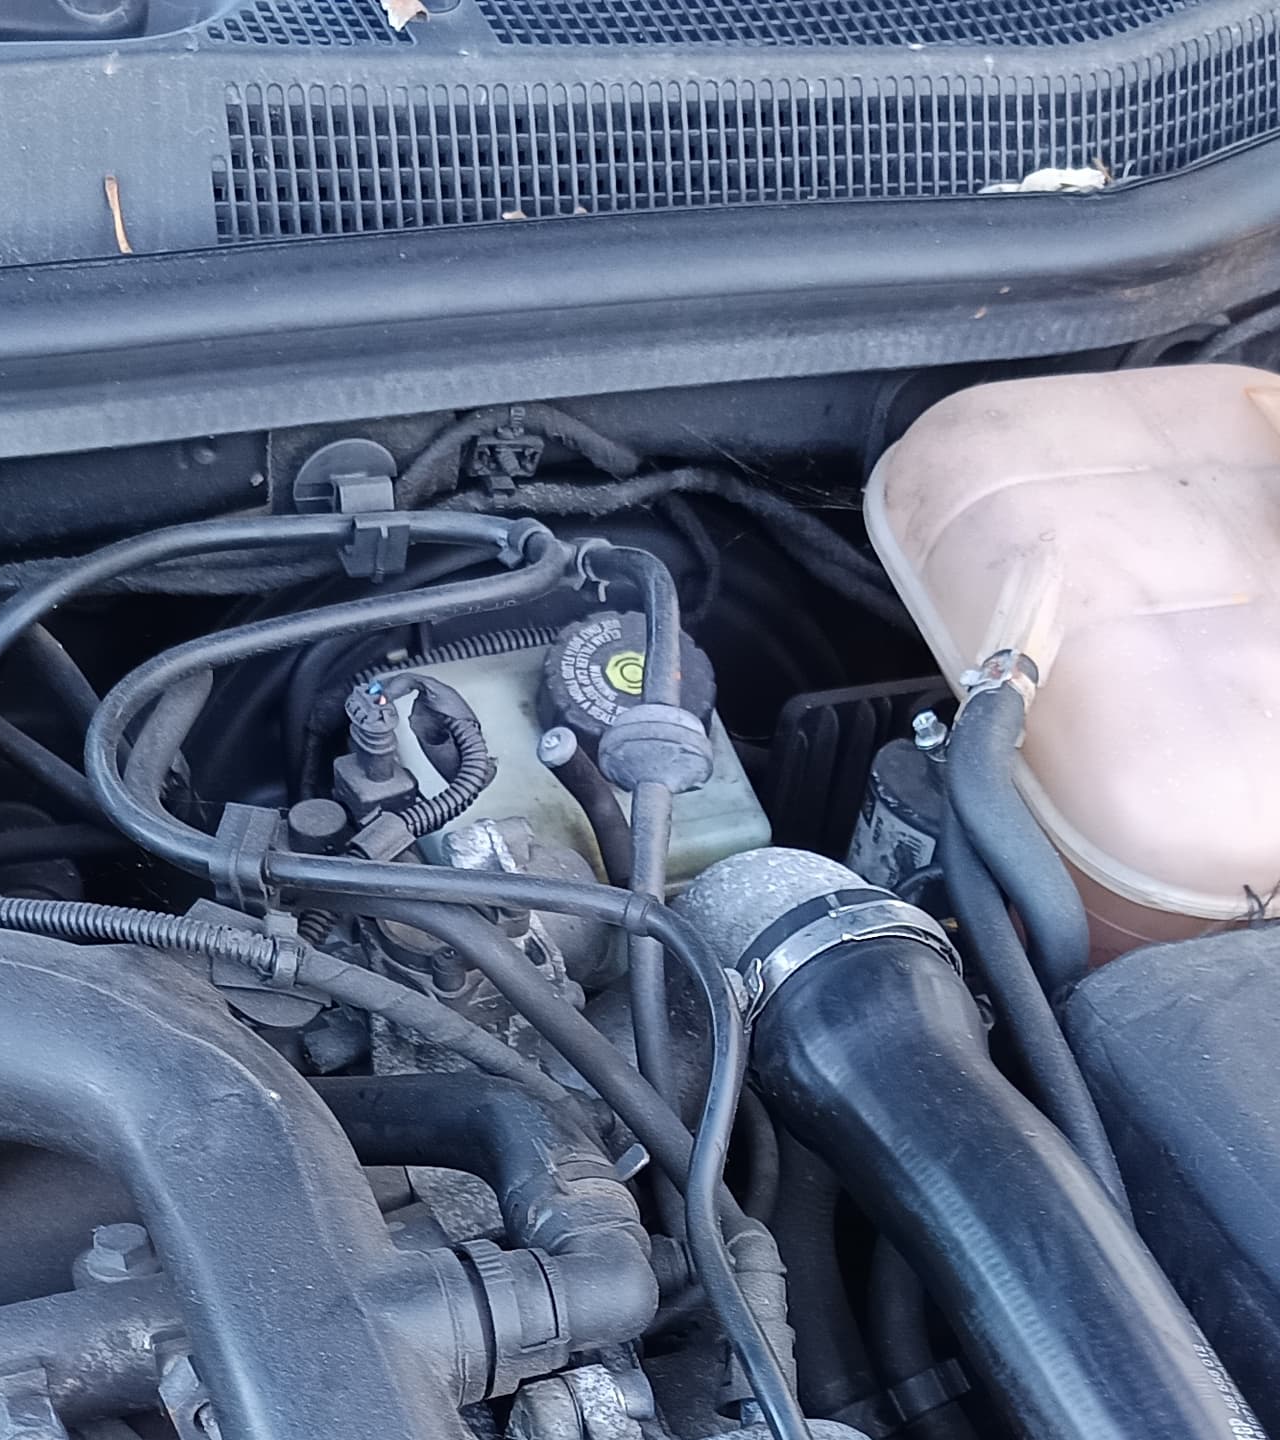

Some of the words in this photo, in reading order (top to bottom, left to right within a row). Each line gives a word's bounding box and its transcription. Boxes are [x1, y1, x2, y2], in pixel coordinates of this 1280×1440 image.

[580, 623, 603, 640] ONLY
[590, 629, 622, 648] CLEAN
[575, 642, 597, 669] FILLER
[561, 655, 576, 680] FLUID
[575, 669, 591, 686] CAP
